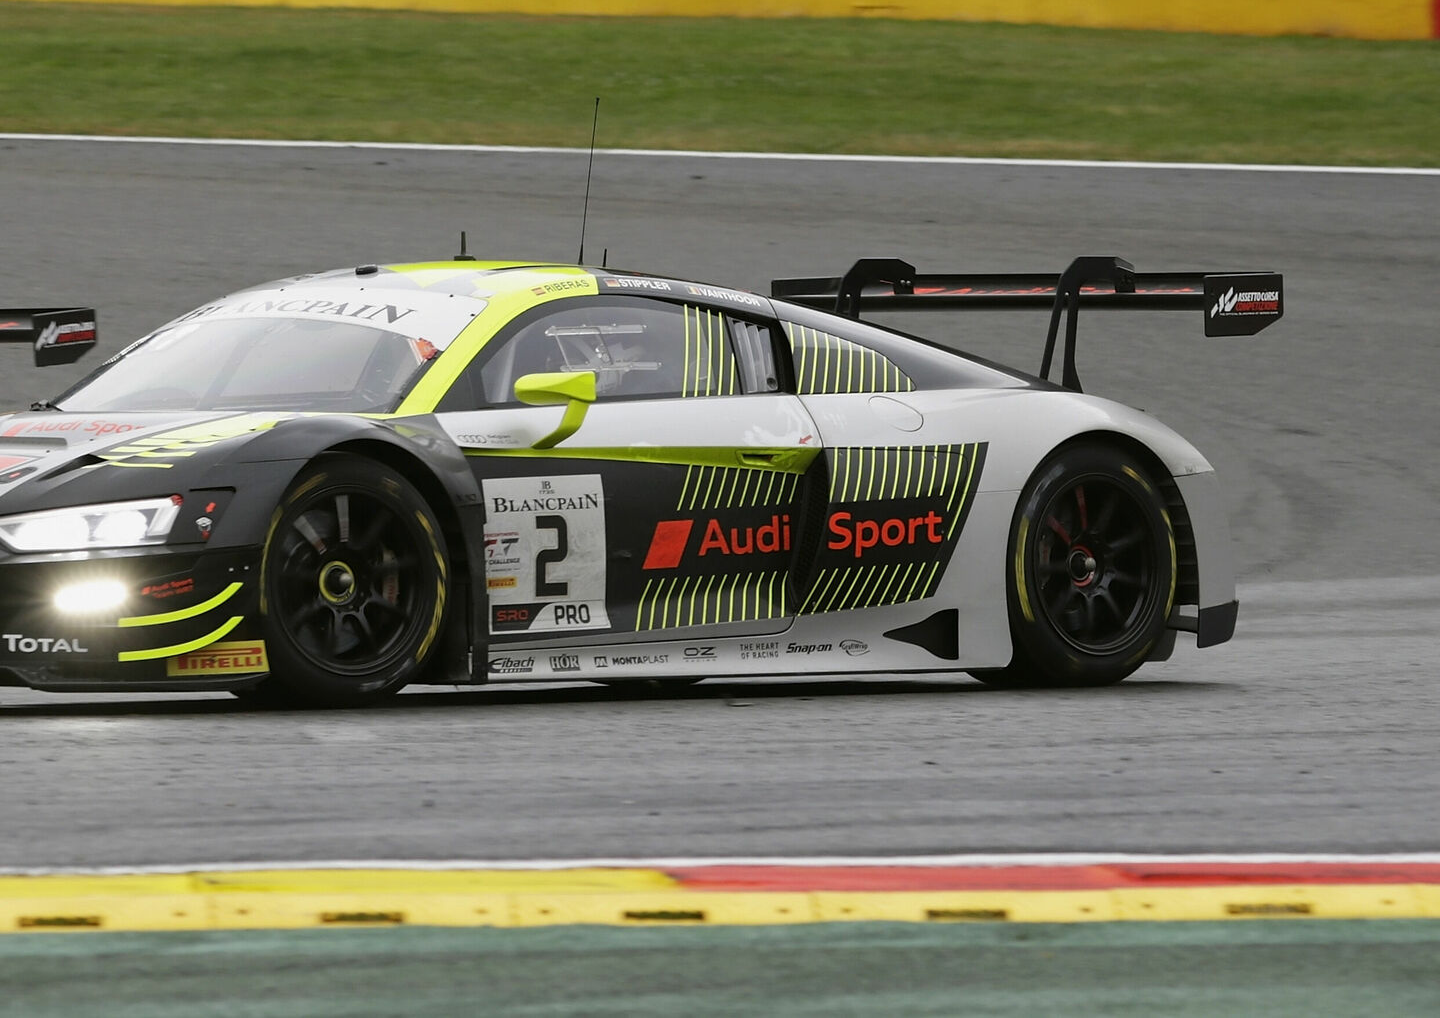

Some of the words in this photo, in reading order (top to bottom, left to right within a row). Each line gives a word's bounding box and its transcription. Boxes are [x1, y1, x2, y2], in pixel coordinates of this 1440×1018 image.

[545, 280, 589, 293] RIBERAS
[619, 278, 671, 291] STIPPLER
[699, 287, 761, 306] VANTHOOR
[493, 493, 599, 513] BLANCPAIN
[698, 514, 791, 556] Audi
[827, 511, 943, 558] Sport
[535, 515, 568, 597] 2
[496, 609, 528, 622] SRO
[554, 603, 591, 625] PRO
[2, 634, 89, 653] TOTAL
[740, 643, 753, 651] THE
[756, 642, 779, 650] HEART
[177, 647, 263, 670] PIRELLI
[612, 654, 669, 664] MONTAPLAST
[741, 651, 749, 659] OF
[752, 650, 779, 658] RACING
[488, 657, 536, 673] Eibach
